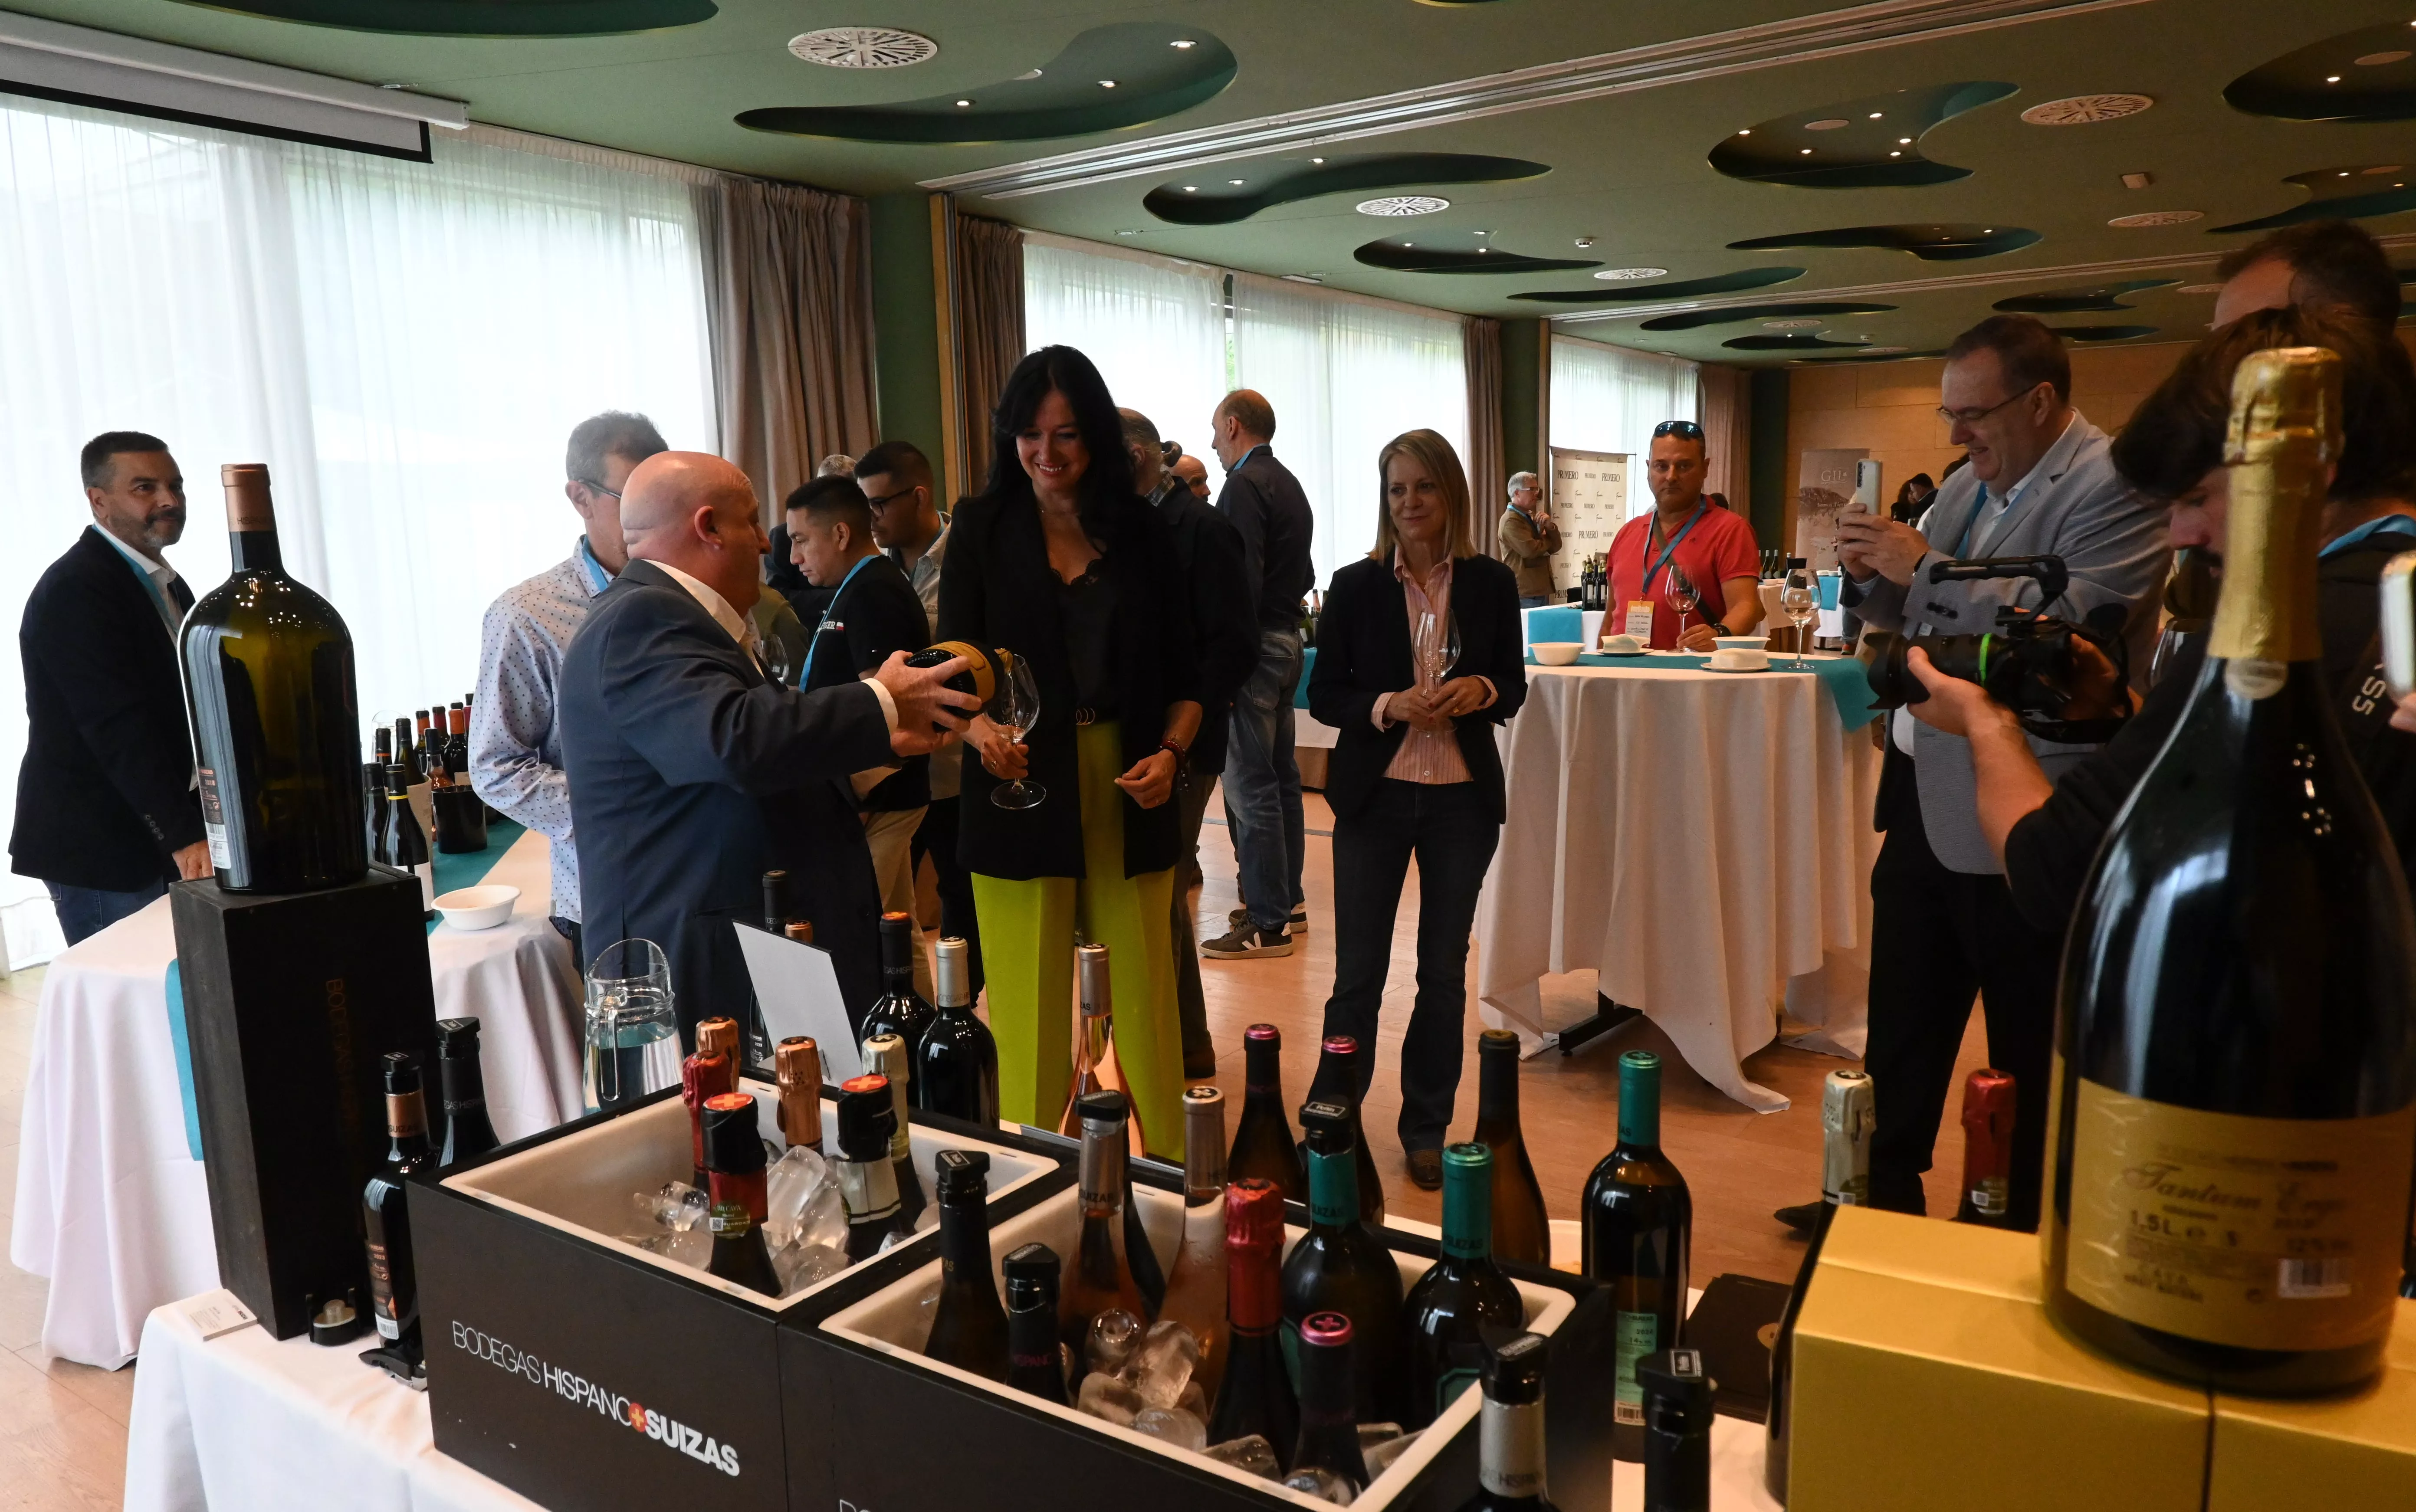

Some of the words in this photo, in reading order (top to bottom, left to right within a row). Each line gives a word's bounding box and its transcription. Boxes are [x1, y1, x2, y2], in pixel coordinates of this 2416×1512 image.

[1557, 470, 1579, 480] PRIMERO
[1602, 473, 1620, 482] PRIMERO
[1822, 470, 1845, 482] GIL
[1555, 589, 1568, 599] PRIM
[452, 1320, 542, 1384] BODEGAS
[543, 1362, 631, 1428] HISPANO
[645, 1409, 740, 1477] SUIZAS
